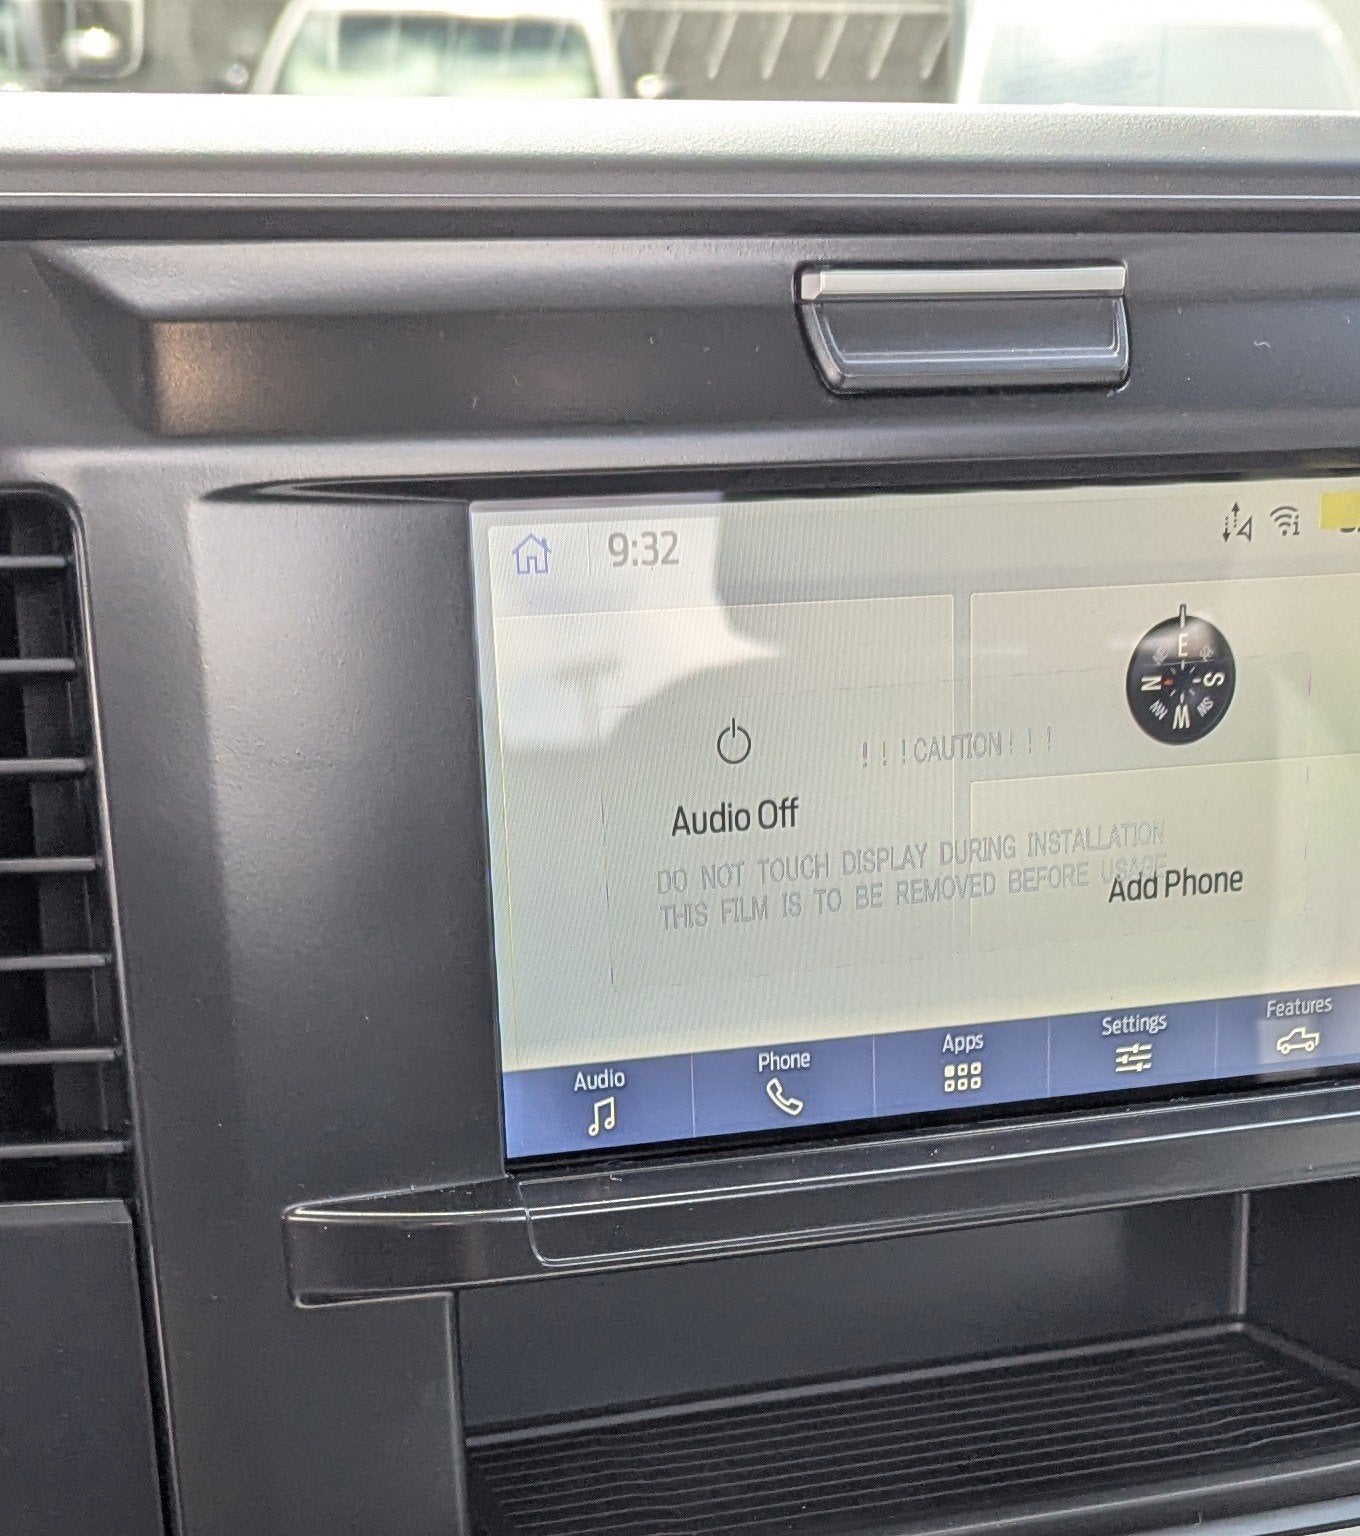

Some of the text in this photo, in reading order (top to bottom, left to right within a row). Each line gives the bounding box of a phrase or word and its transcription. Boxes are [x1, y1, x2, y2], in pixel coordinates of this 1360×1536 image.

[607, 530, 680, 568] 9:32
[671, 796, 799, 837] Audio Off
[656, 819, 1167, 895] DO NOT TOUCH DISPLAY DURING INSTALLATION
[659, 902, 708, 930] THIS
[720, 895, 769, 924] FILM
[782, 891, 802, 918] IS
[813, 887, 842, 914] TO
[855, 882, 883, 910] BE
[896, 871, 996, 906] REMOVED
[1008, 862, 1090, 894] BEFORE
[1108, 866, 1244, 903] Add Phone
[1266, 995, 1333, 1019] Features
[1101, 1013, 1168, 1037] Settings
[942, 1033, 985, 1055] Apps
[758, 1051, 811, 1073] Phone
[572, 1069, 626, 1092] Audio
